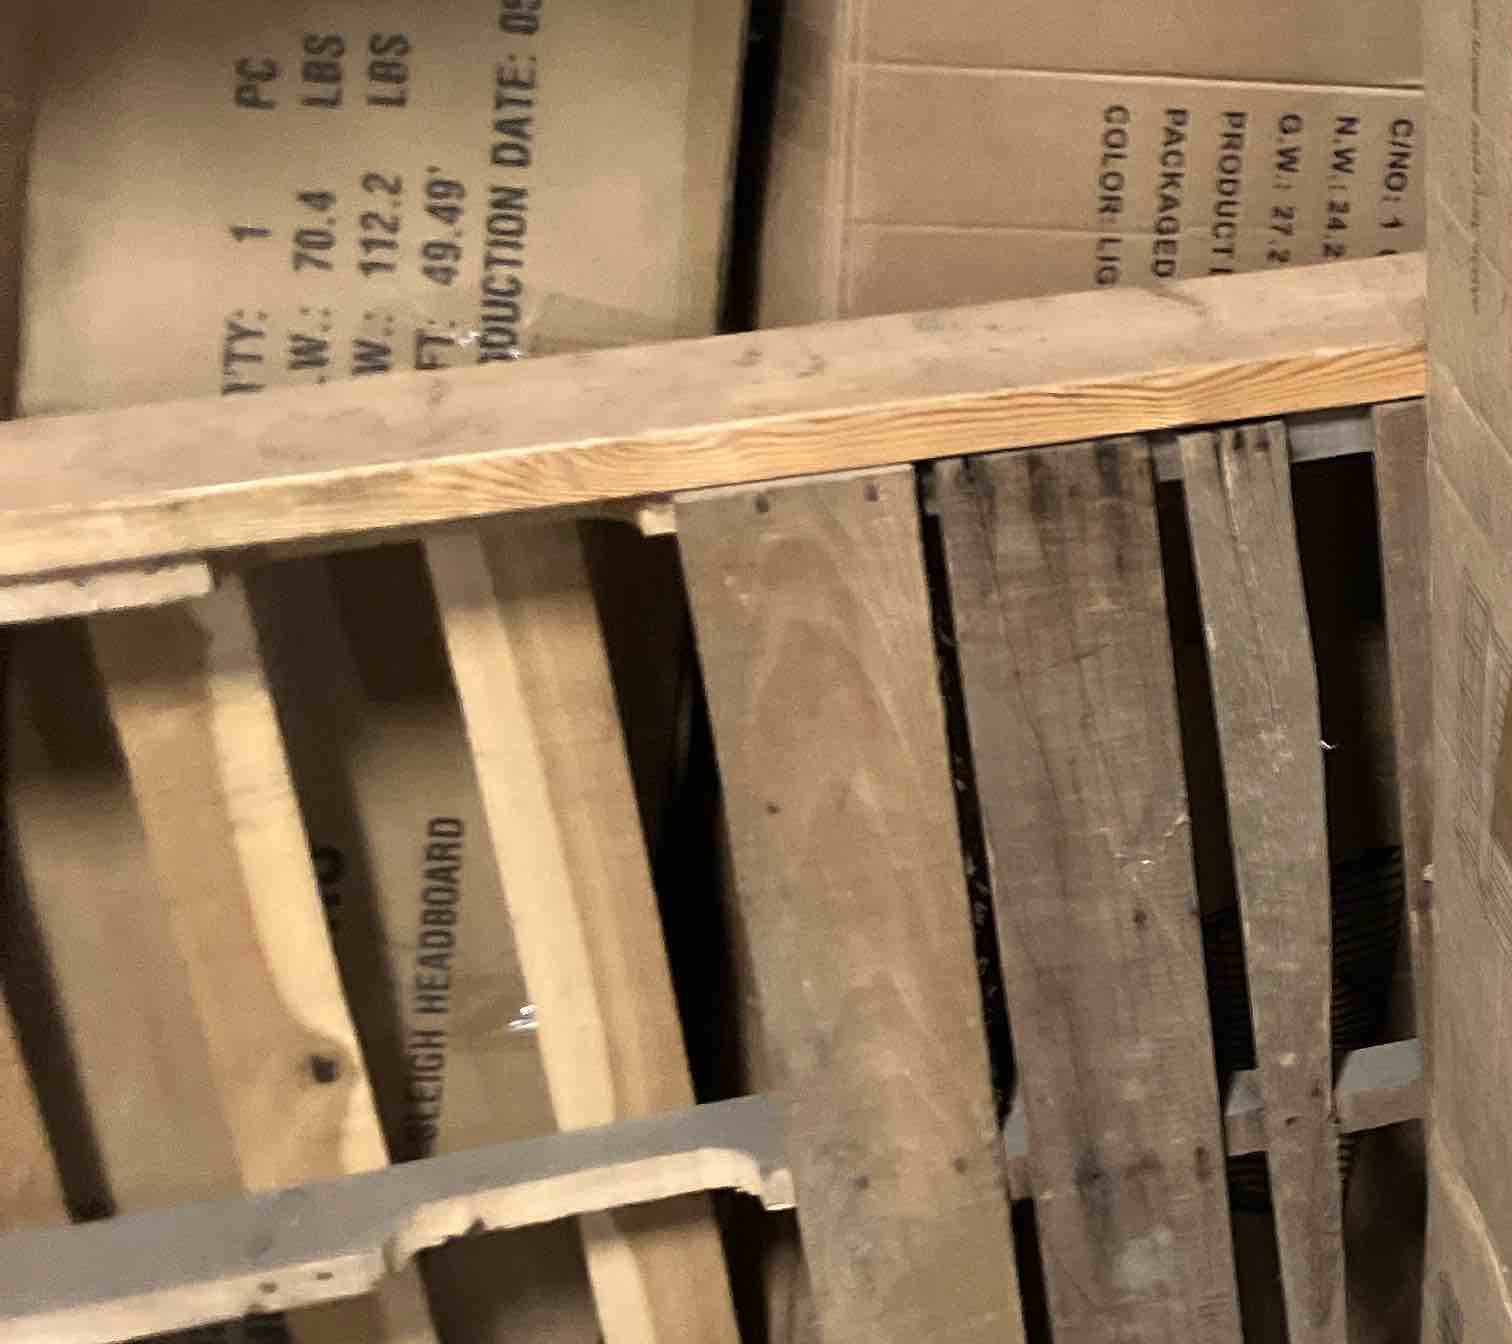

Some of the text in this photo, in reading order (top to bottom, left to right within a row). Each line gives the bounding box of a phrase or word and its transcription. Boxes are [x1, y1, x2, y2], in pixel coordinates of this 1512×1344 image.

[232, 57, 278, 111] PC
[300, 32, 347, 111] LBS
[366, 32, 412, 111] LBS
[487, 53, 538, 169] DATE:
[290, 190, 338, 273] 70.4
[357, 170, 403, 280] 112.2
[1149, 107, 1189, 281] PACKAGED
[1210, 111, 1248, 260] PRODUCT
[228, 225, 273, 244] 1
[412, 815, 466, 1016] HEADBOARD
